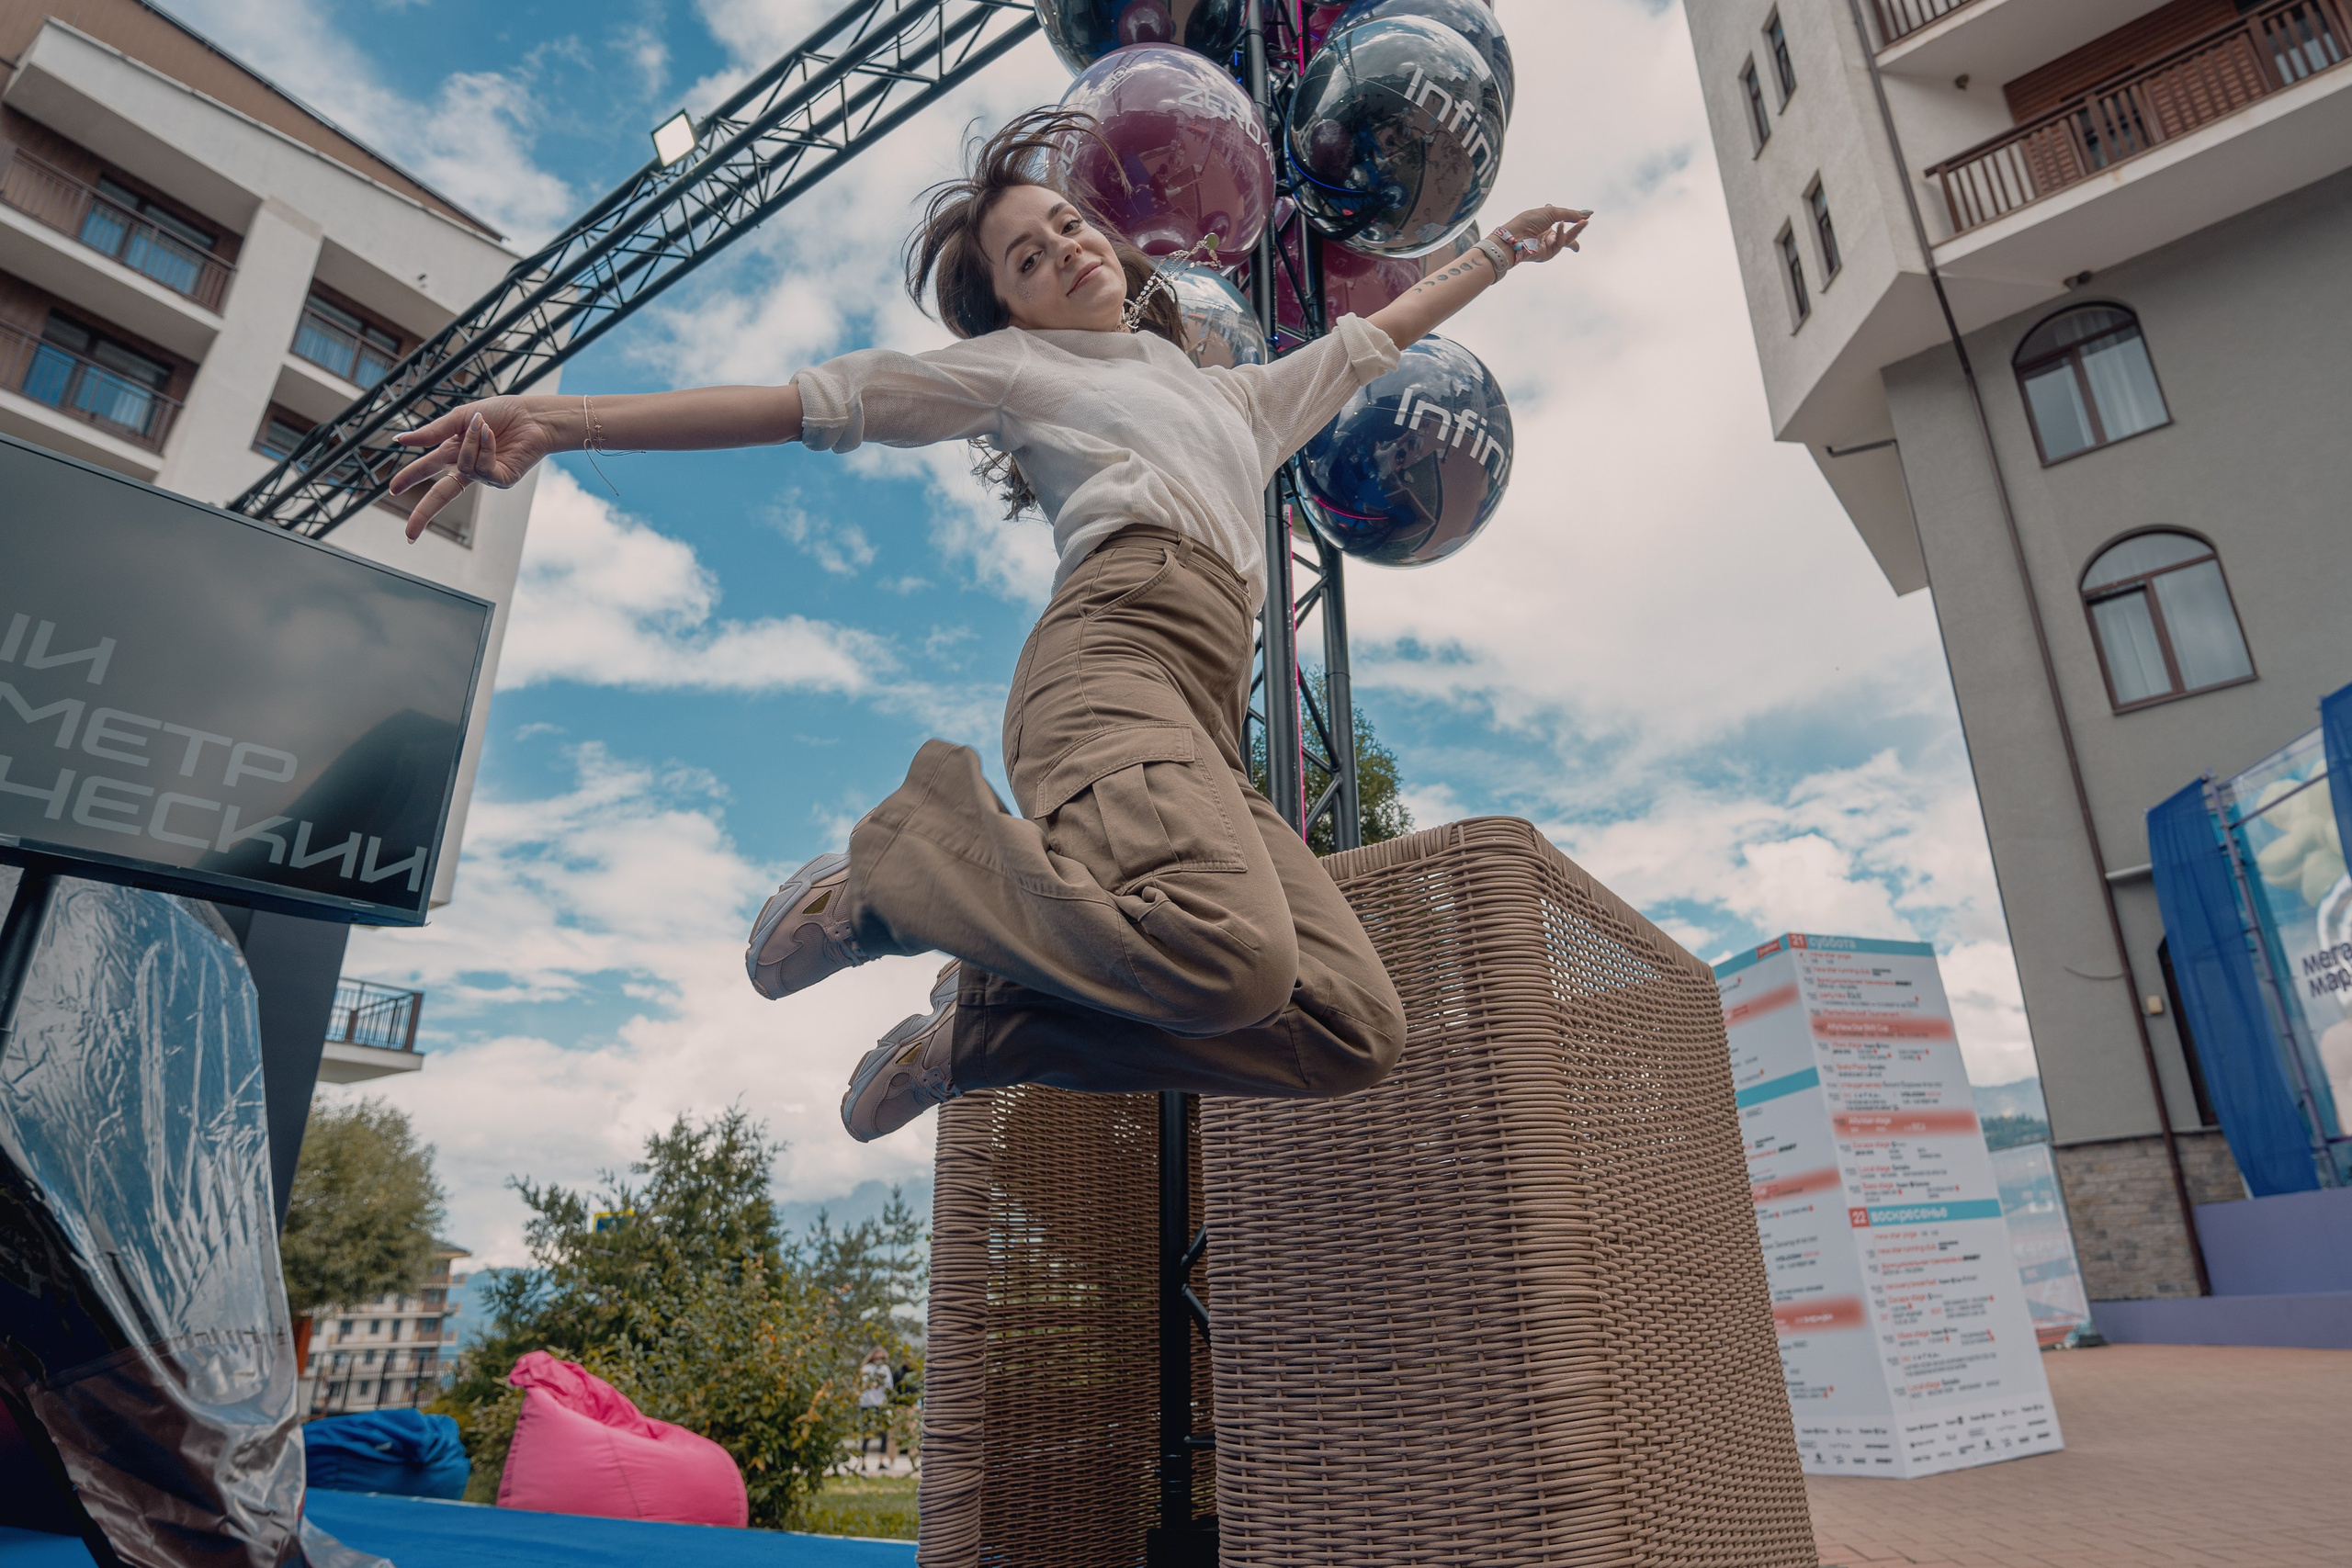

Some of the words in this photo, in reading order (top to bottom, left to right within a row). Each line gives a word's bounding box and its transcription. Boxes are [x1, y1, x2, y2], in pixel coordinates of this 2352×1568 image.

[1404, 67, 1499, 194] Infini
[1394, 388, 1511, 492] Infini
[0, 681, 299, 788] МЕТР
[1791, 934, 1805, 948] 21
[1808, 935, 1857, 951] суббота
[1851, 1211, 1868, 1224] 22
[1871, 1207, 1948, 1224] воскресенье
